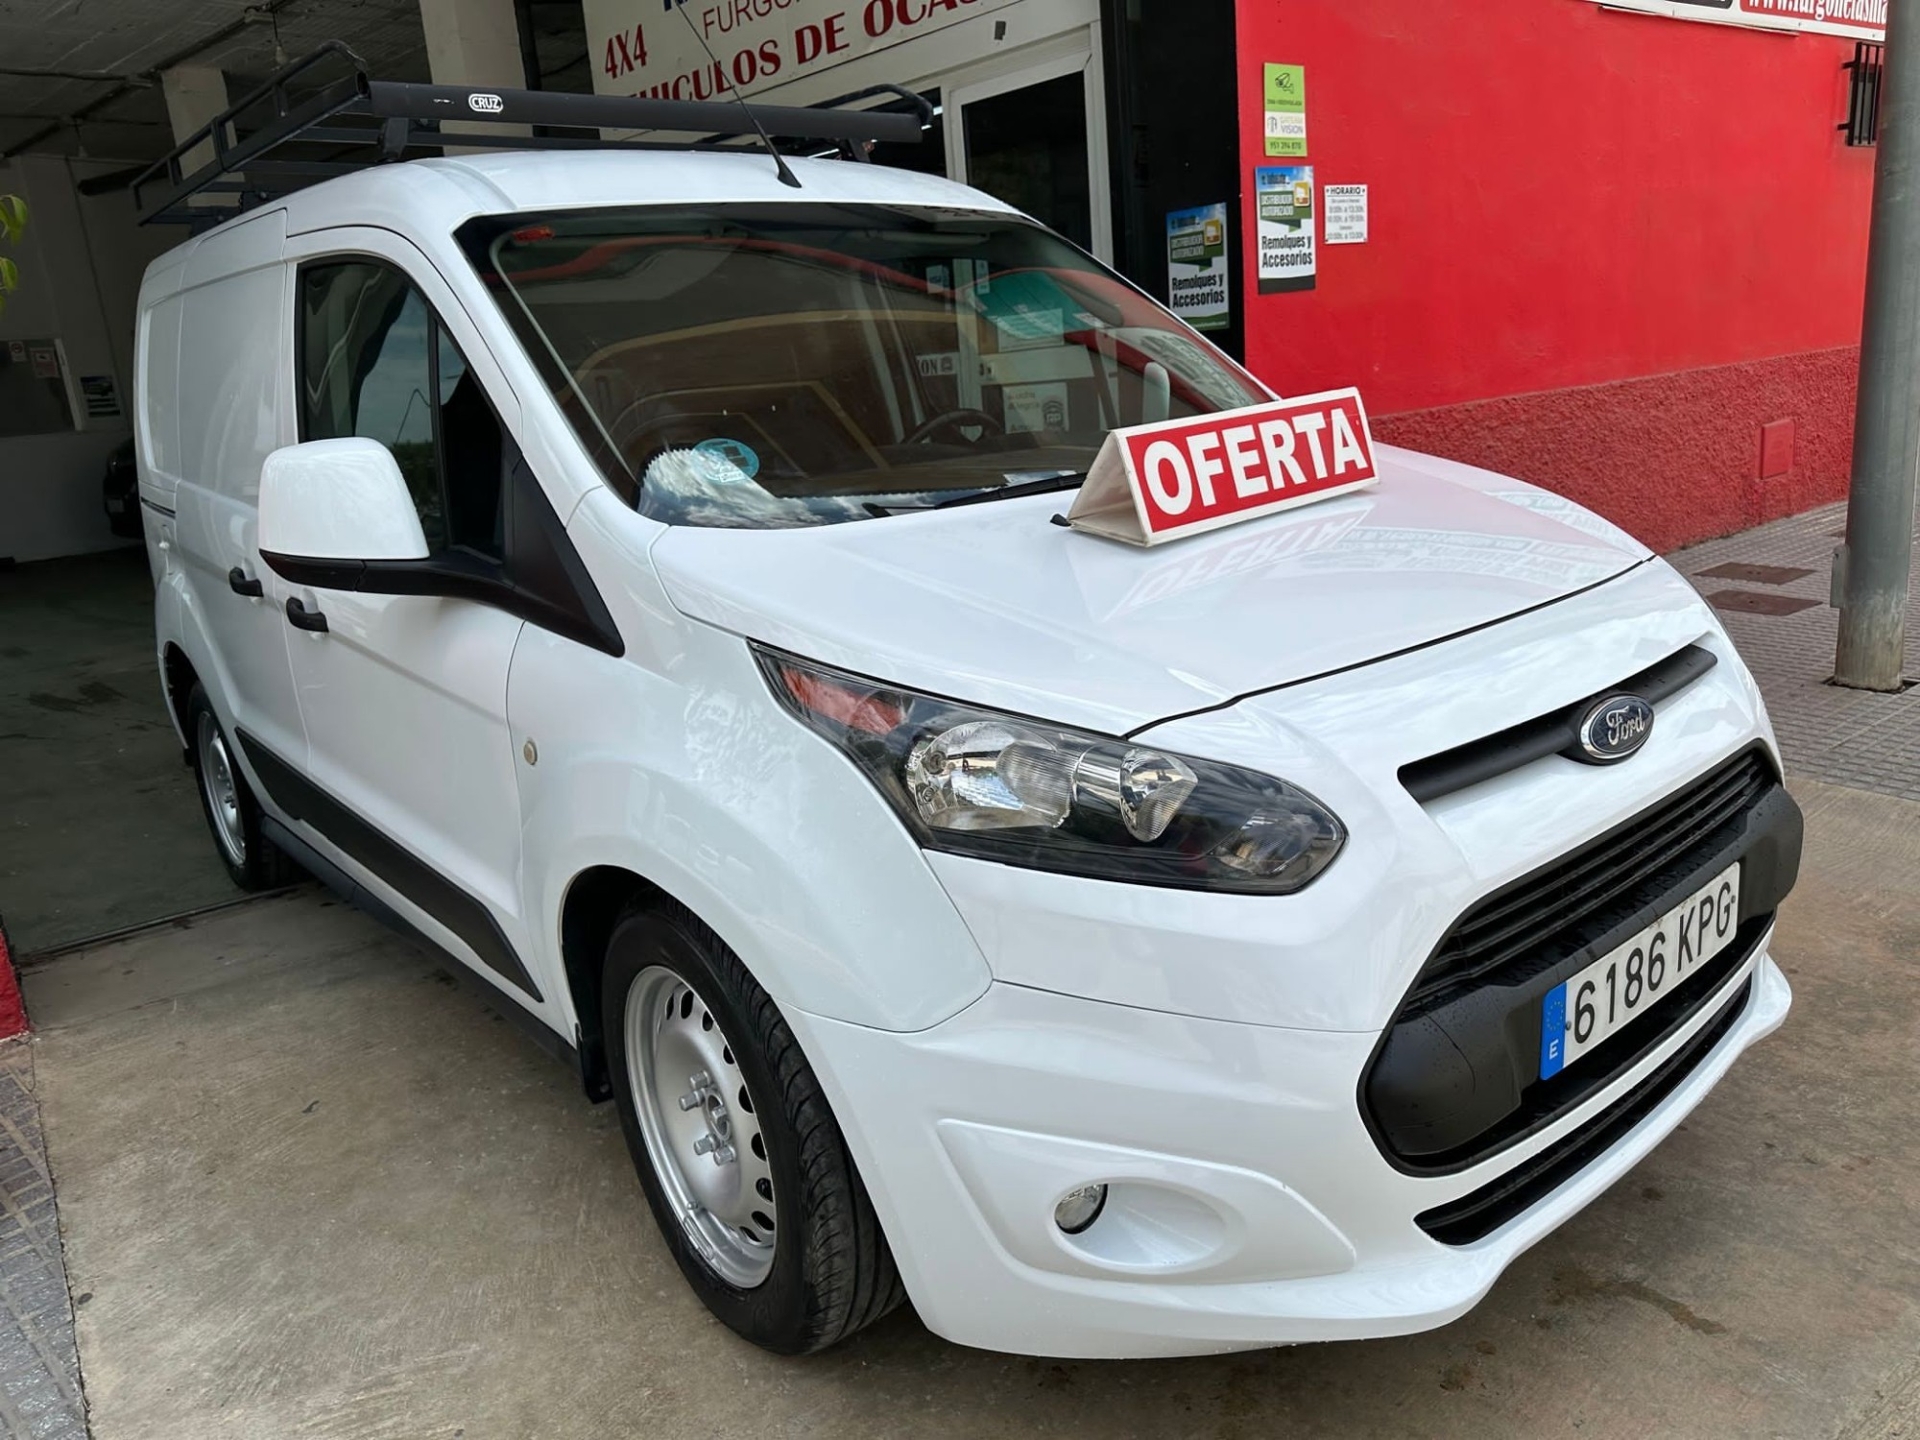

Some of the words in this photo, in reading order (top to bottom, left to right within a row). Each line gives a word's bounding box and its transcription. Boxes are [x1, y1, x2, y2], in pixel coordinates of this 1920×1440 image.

[794, 12, 850, 64] DE
[604, 23, 648, 80] 4X4
[472, 97, 500, 109] CRUZ
[1330, 187, 1361, 195] HORARIO
[1261, 235, 1306, 250] Remolques
[1307, 236, 1312, 248] y
[1262, 250, 1313, 269] Accesorios
[1171, 273, 1217, 291] Remolques
[1218, 273, 1224, 288] y
[1172, 289, 1225, 309] Accesorios
[1143, 407, 1369, 516] OFERTA
[1606, 705, 1646, 746] Ford
[1573, 930, 1666, 1045] 6186
[1677, 881, 1732, 973] KPG
[1549, 1038, 1559, 1060] E
